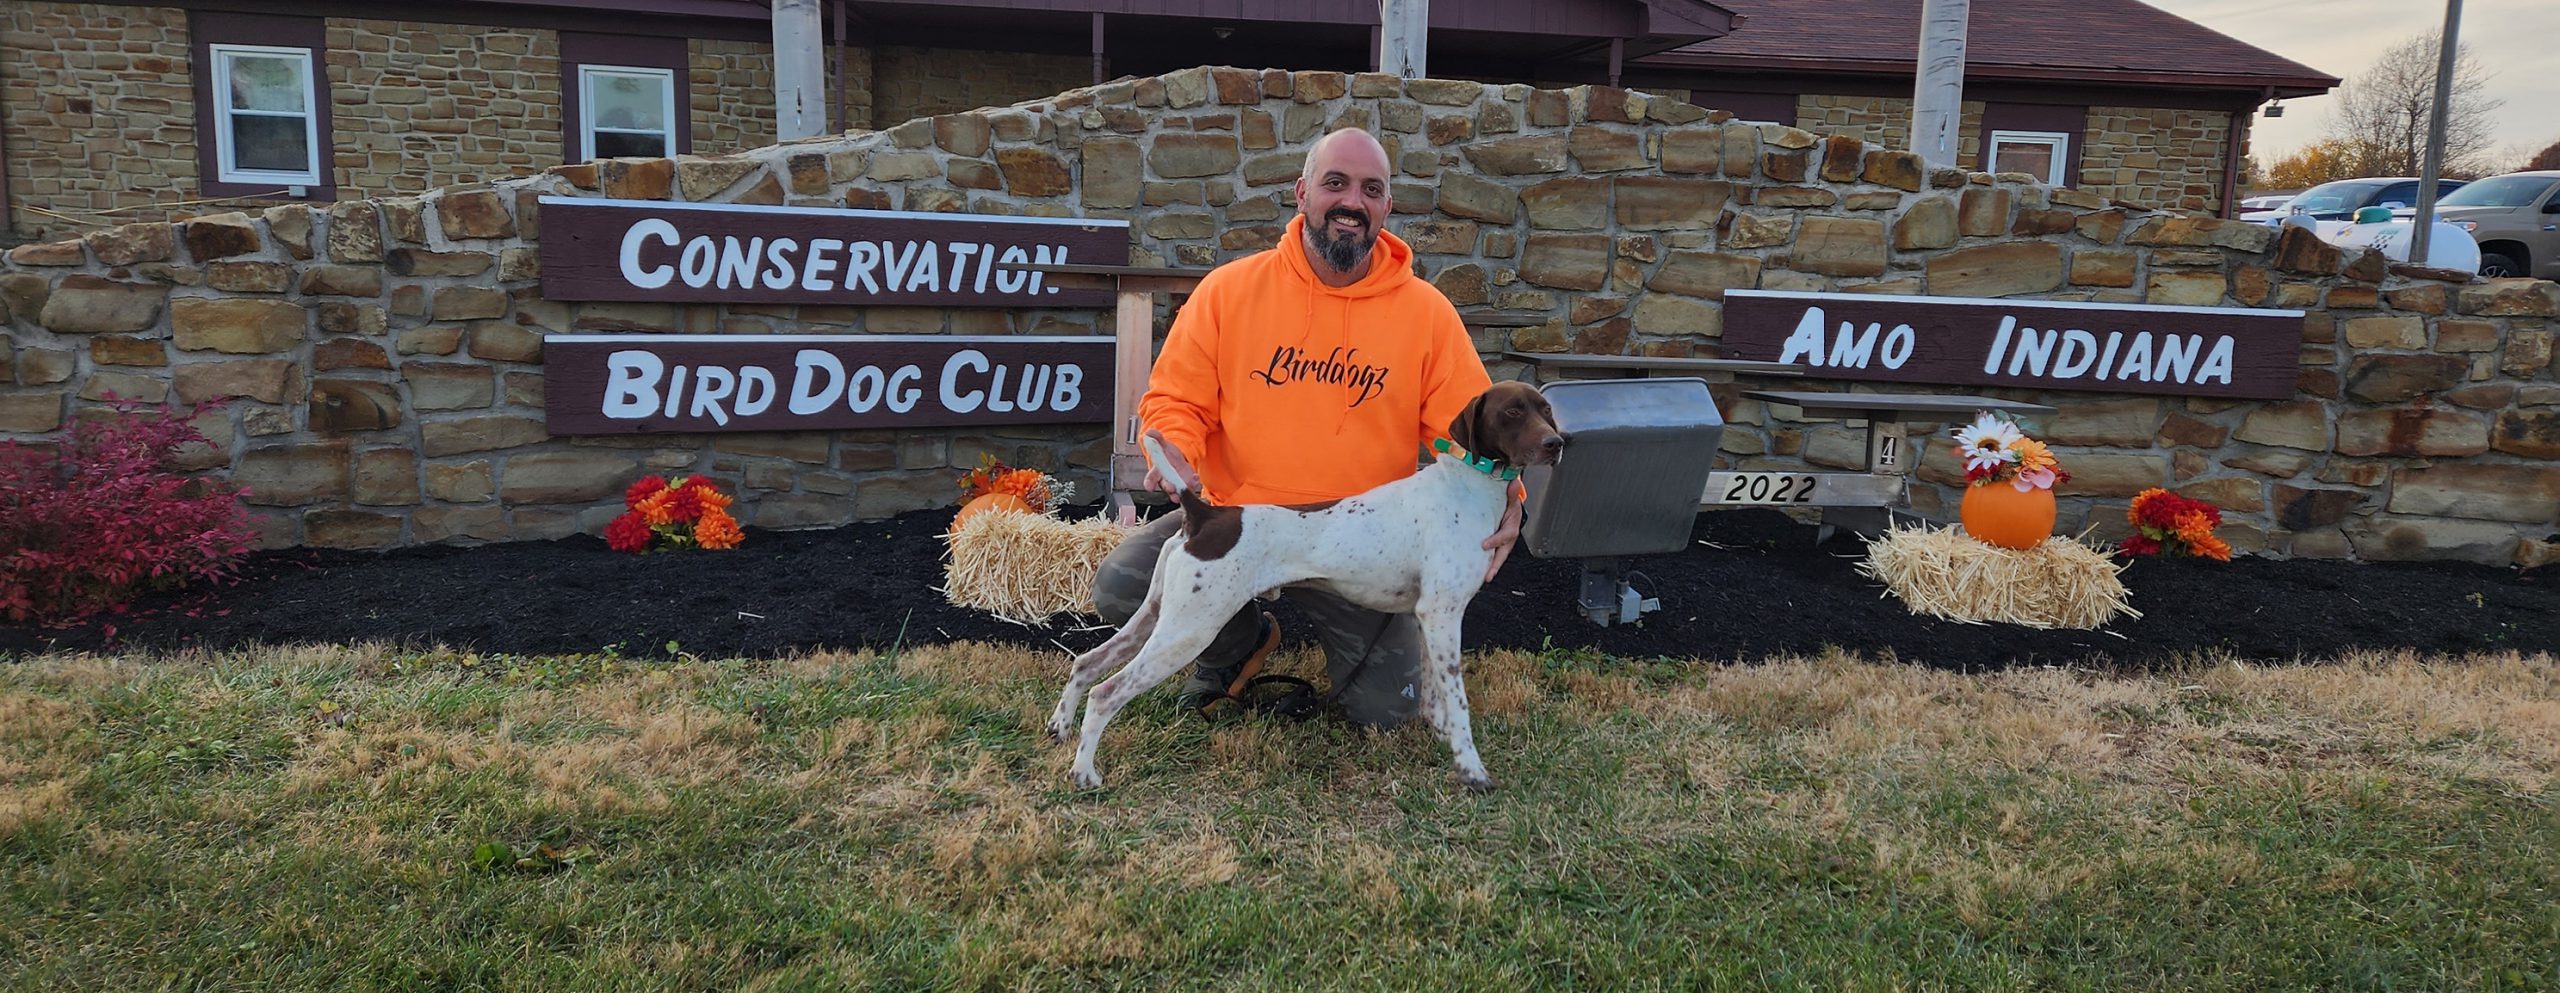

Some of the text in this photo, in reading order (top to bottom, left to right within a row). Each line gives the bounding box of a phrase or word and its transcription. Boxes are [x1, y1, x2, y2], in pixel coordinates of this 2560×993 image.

[619, 217, 1068, 296] CONSERVATION
[1250, 345, 1389, 407] Birddogz
[1779, 306, 2236, 385] AMO INDIANA
[601, 349, 1083, 426] BIRD DOG CLUB
[1881, 437, 1895, 465] 4
[1725, 475, 1816, 503] 2022
